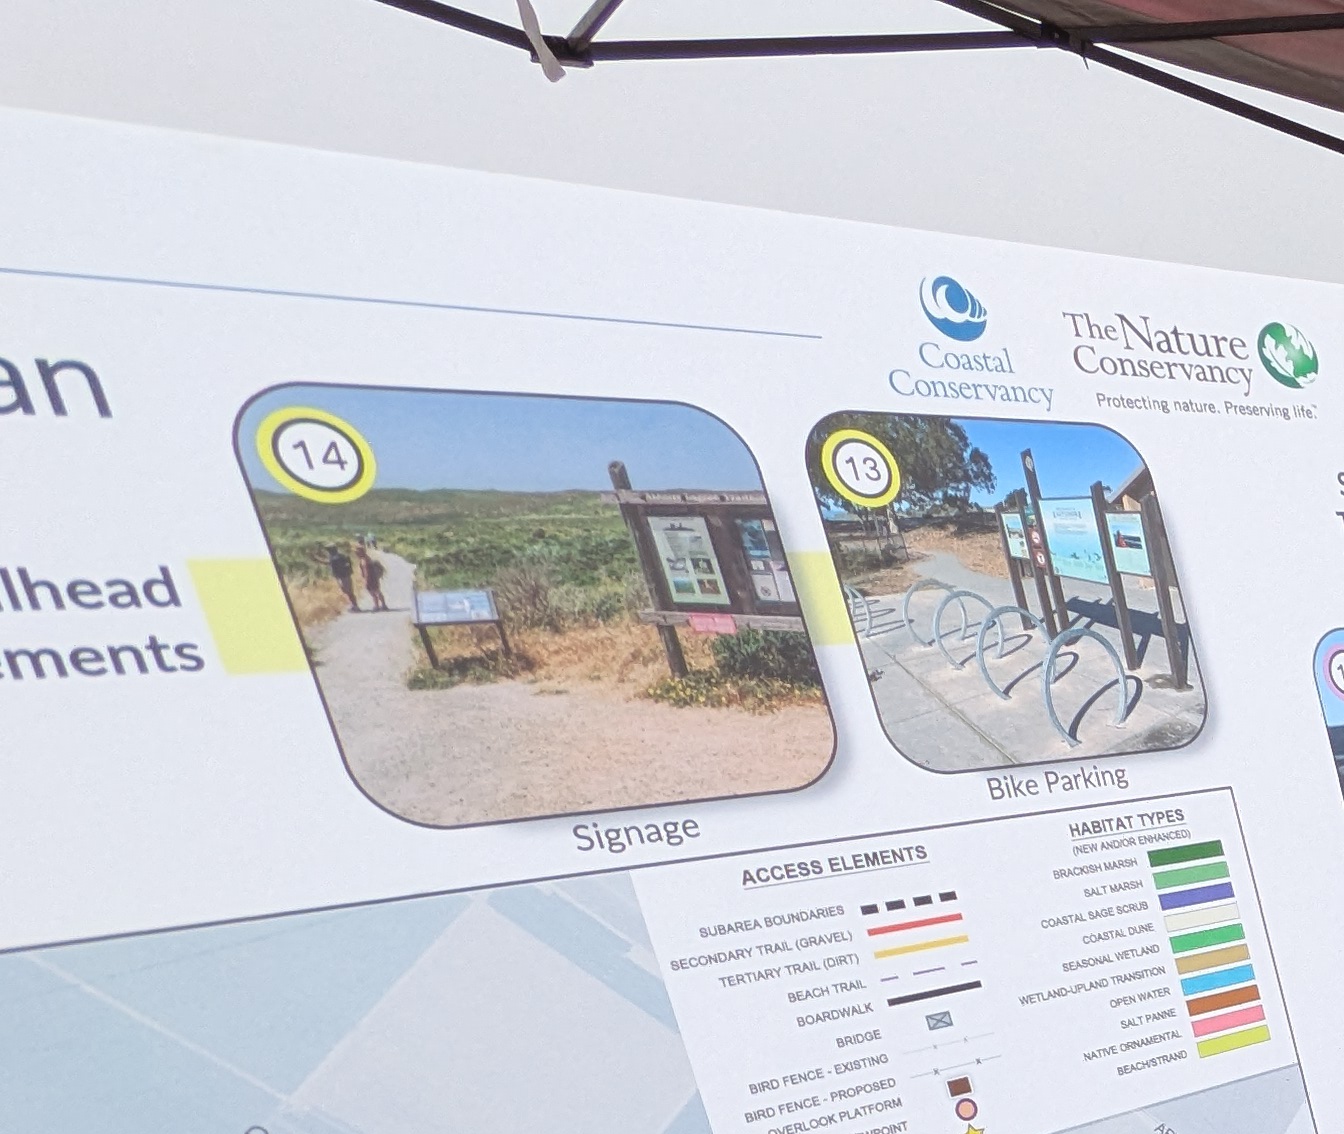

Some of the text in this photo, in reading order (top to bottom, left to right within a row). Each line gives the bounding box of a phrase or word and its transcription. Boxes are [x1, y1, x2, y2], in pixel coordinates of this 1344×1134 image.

[1062, 311, 1249, 361] The Nature
[918, 342, 1015, 374] Coastal
[1073, 345, 1253, 396] Conservancy
[888, 369, 1054, 411] Conservancy
[1096, 392, 1291, 421] Protecting nature. Preserving
[292, 441, 348, 472] 14
[845, 456, 881, 482] 13
[987, 764, 1130, 801] Bike Parking
[572, 814, 700, 854] Signage
[1069, 808, 1185, 838] HABITAT TYPES
[742, 845, 927, 886] ACCESS ELEMENTS
[1053, 858, 1138, 880] BRACKISH MARSH
[1084, 880, 1143, 898] SALT MARSH
[699, 905, 844, 938] SUBAREA BOUNDARIES
[1041, 901, 1149, 929] COASTAL SAGE SCRUB
[1083, 922, 1154, 944] COASTAL DUNE
[670, 930, 852, 971] SECONDARY TRAIL (GRAVEL)
[1062, 944, 1160, 972] SEASONAL WETLAND
[719, 953, 859, 988] TERTIARY TRAIL (DIRT)
[788, 979, 867, 1003] BEACH TRAIL
[1018, 966, 1166, 1006] WETLAND-UPLAND TRANSITION
[1110, 987, 1171, 1009] OPEN WATER
[796, 1002, 874, 1027] BOARDWALK
[1121, 1017, 1144, 1030] SALT
[836, 1030, 881, 1048] BRIDGE
[1084, 1030, 1182, 1062] NATIVE ORNAMENTAL
[749, 1054, 889, 1095] BIRD FENCE EXISTING
[1117, 1050, 1188, 1076] BEACH/STRAND
[744, 1078, 896, 1124] BIRD FENCE PROPOSED
[839, 1098, 903, 1122] PLATFORM
